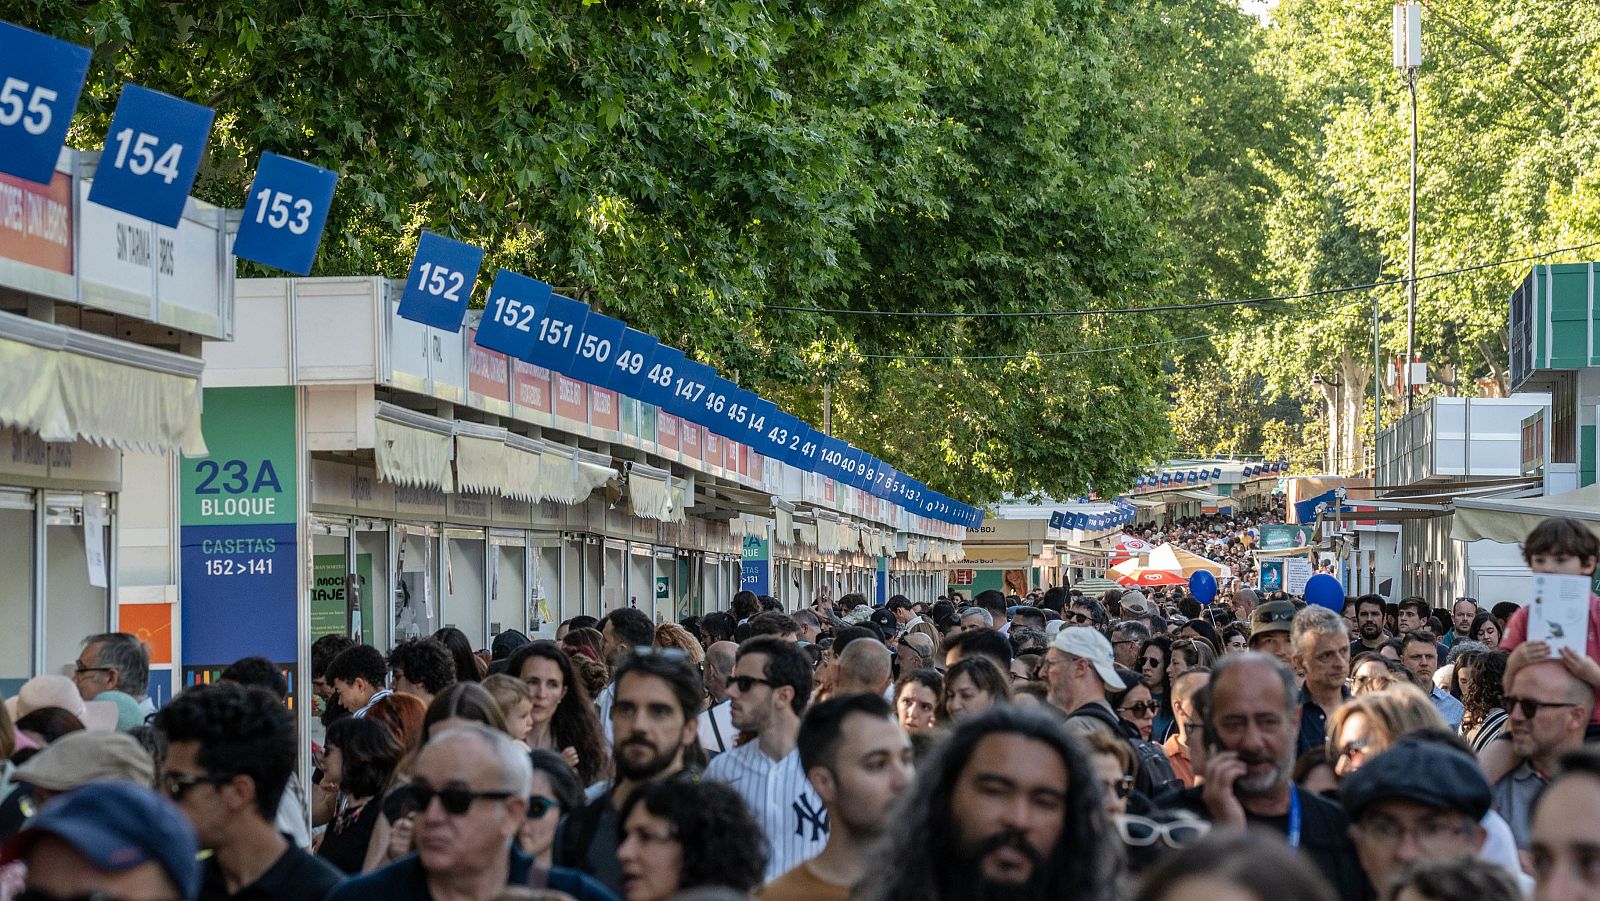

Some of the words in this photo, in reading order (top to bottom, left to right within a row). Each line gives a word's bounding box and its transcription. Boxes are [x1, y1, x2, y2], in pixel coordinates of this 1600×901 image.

[114, 127, 183, 184] 154
[255, 187, 313, 235] 153
[418, 261, 464, 302] 152
[494, 296, 535, 332] 152
[539, 317, 573, 348] 151
[675, 377, 705, 402] 147
[821, 448, 841, 466] 140
[195, 459, 282, 495] 23A
[201, 498, 275, 517] BLOQUE
[202, 538, 275, 555] CASETAS
[792, 792, 831, 841] NY
